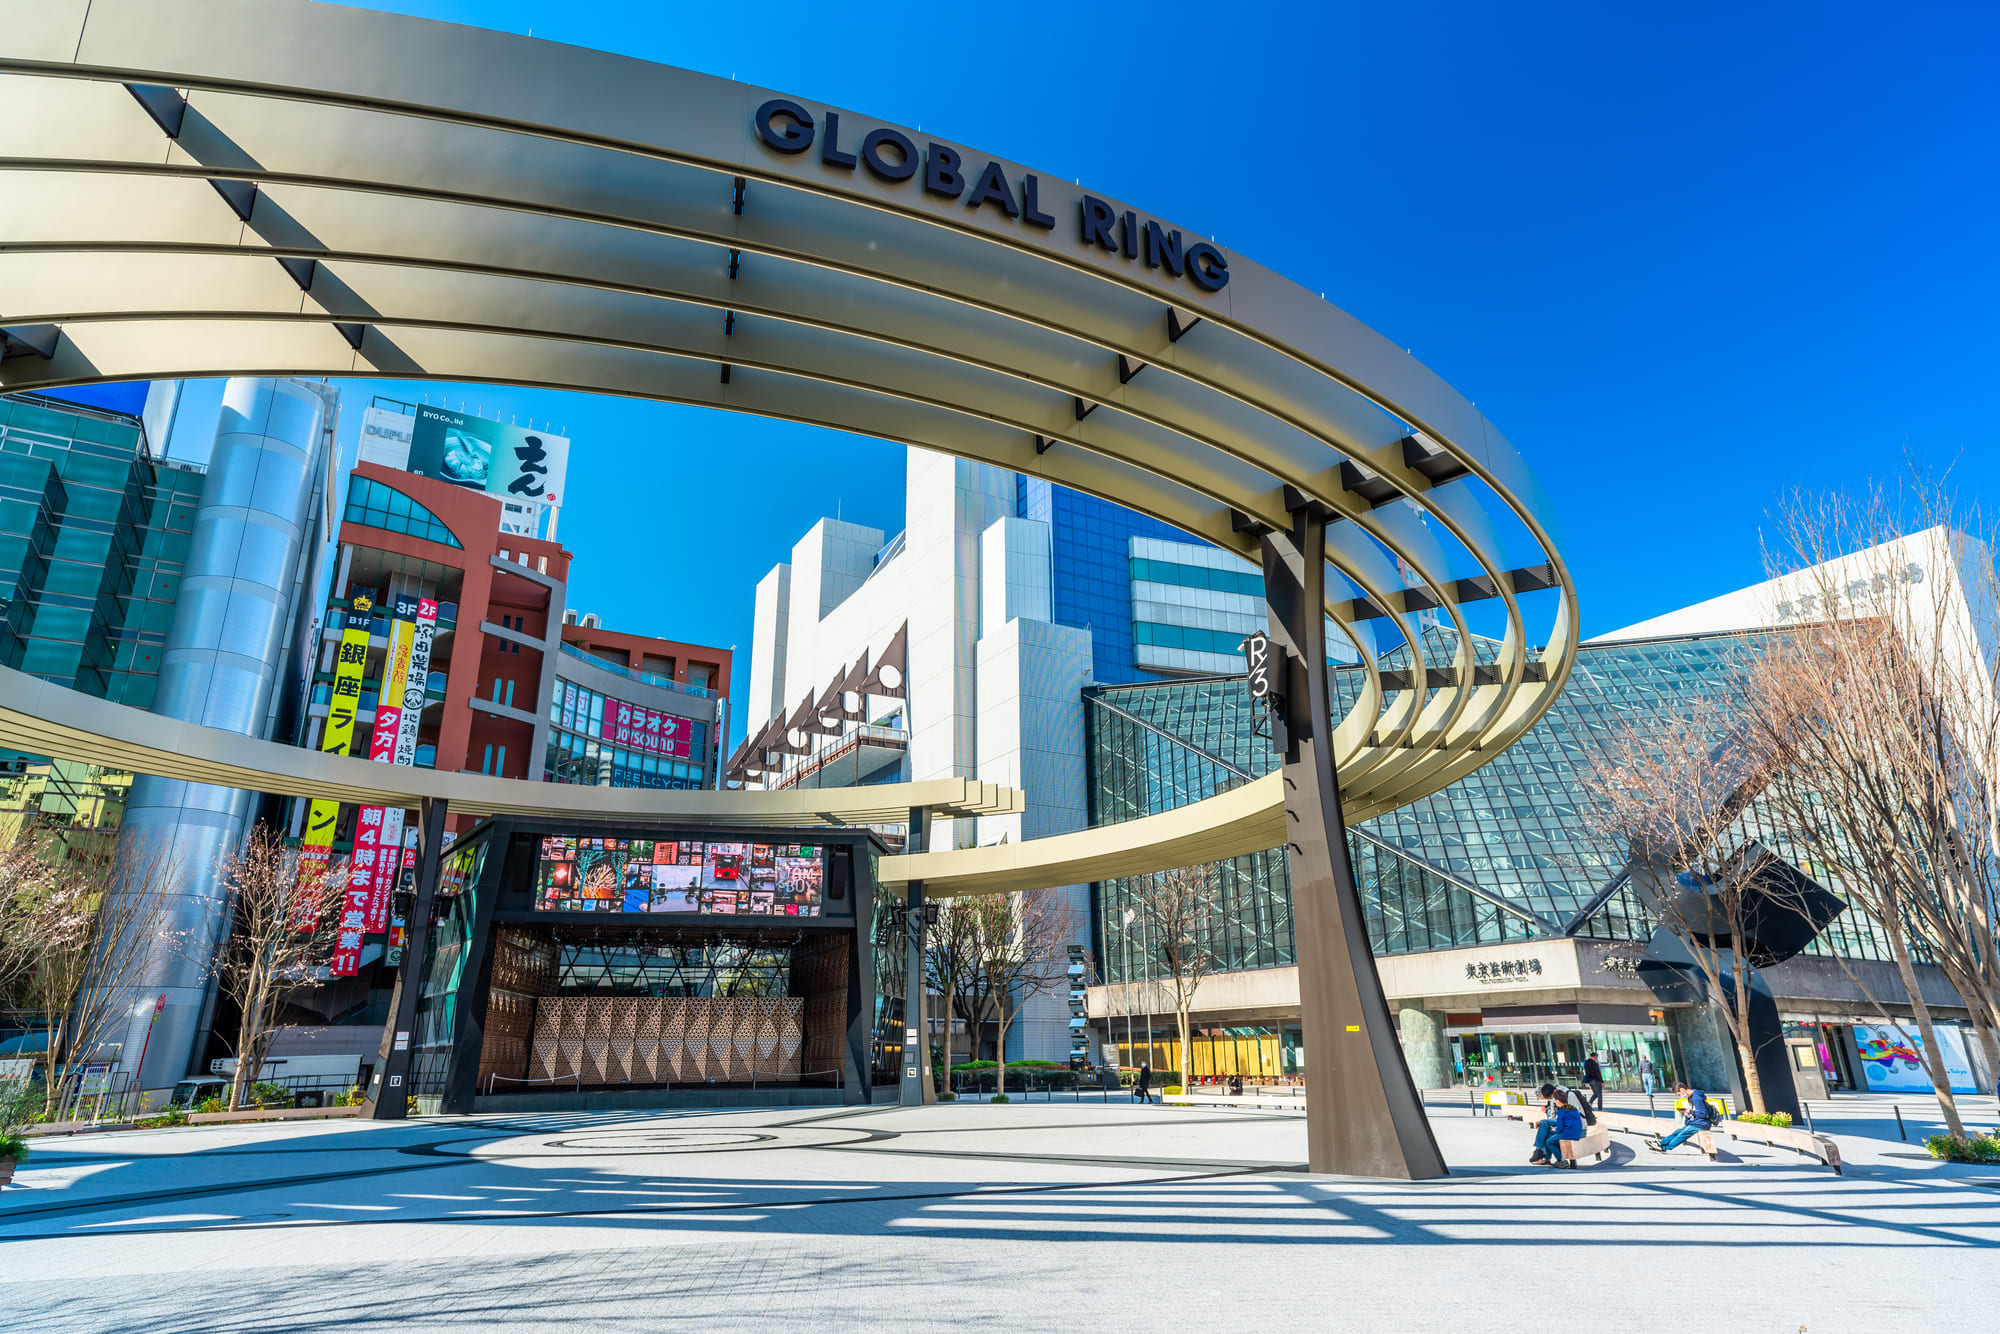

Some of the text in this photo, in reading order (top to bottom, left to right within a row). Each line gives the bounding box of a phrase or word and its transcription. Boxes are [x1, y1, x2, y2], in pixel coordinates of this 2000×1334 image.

[755, 98, 1230, 292] GLOBAL RING
[423, 410, 439, 420] BYO
[508, 436, 548, 497] えん
[396, 601, 418, 616] 3F
[419, 602, 437, 616] 2F
[348, 616, 371, 627] B1F
[616, 706, 679, 736] カラオケ
[616, 727, 675, 752] JOYSOUND
[1465, 958, 1543, 980] 東京芸術劇場
